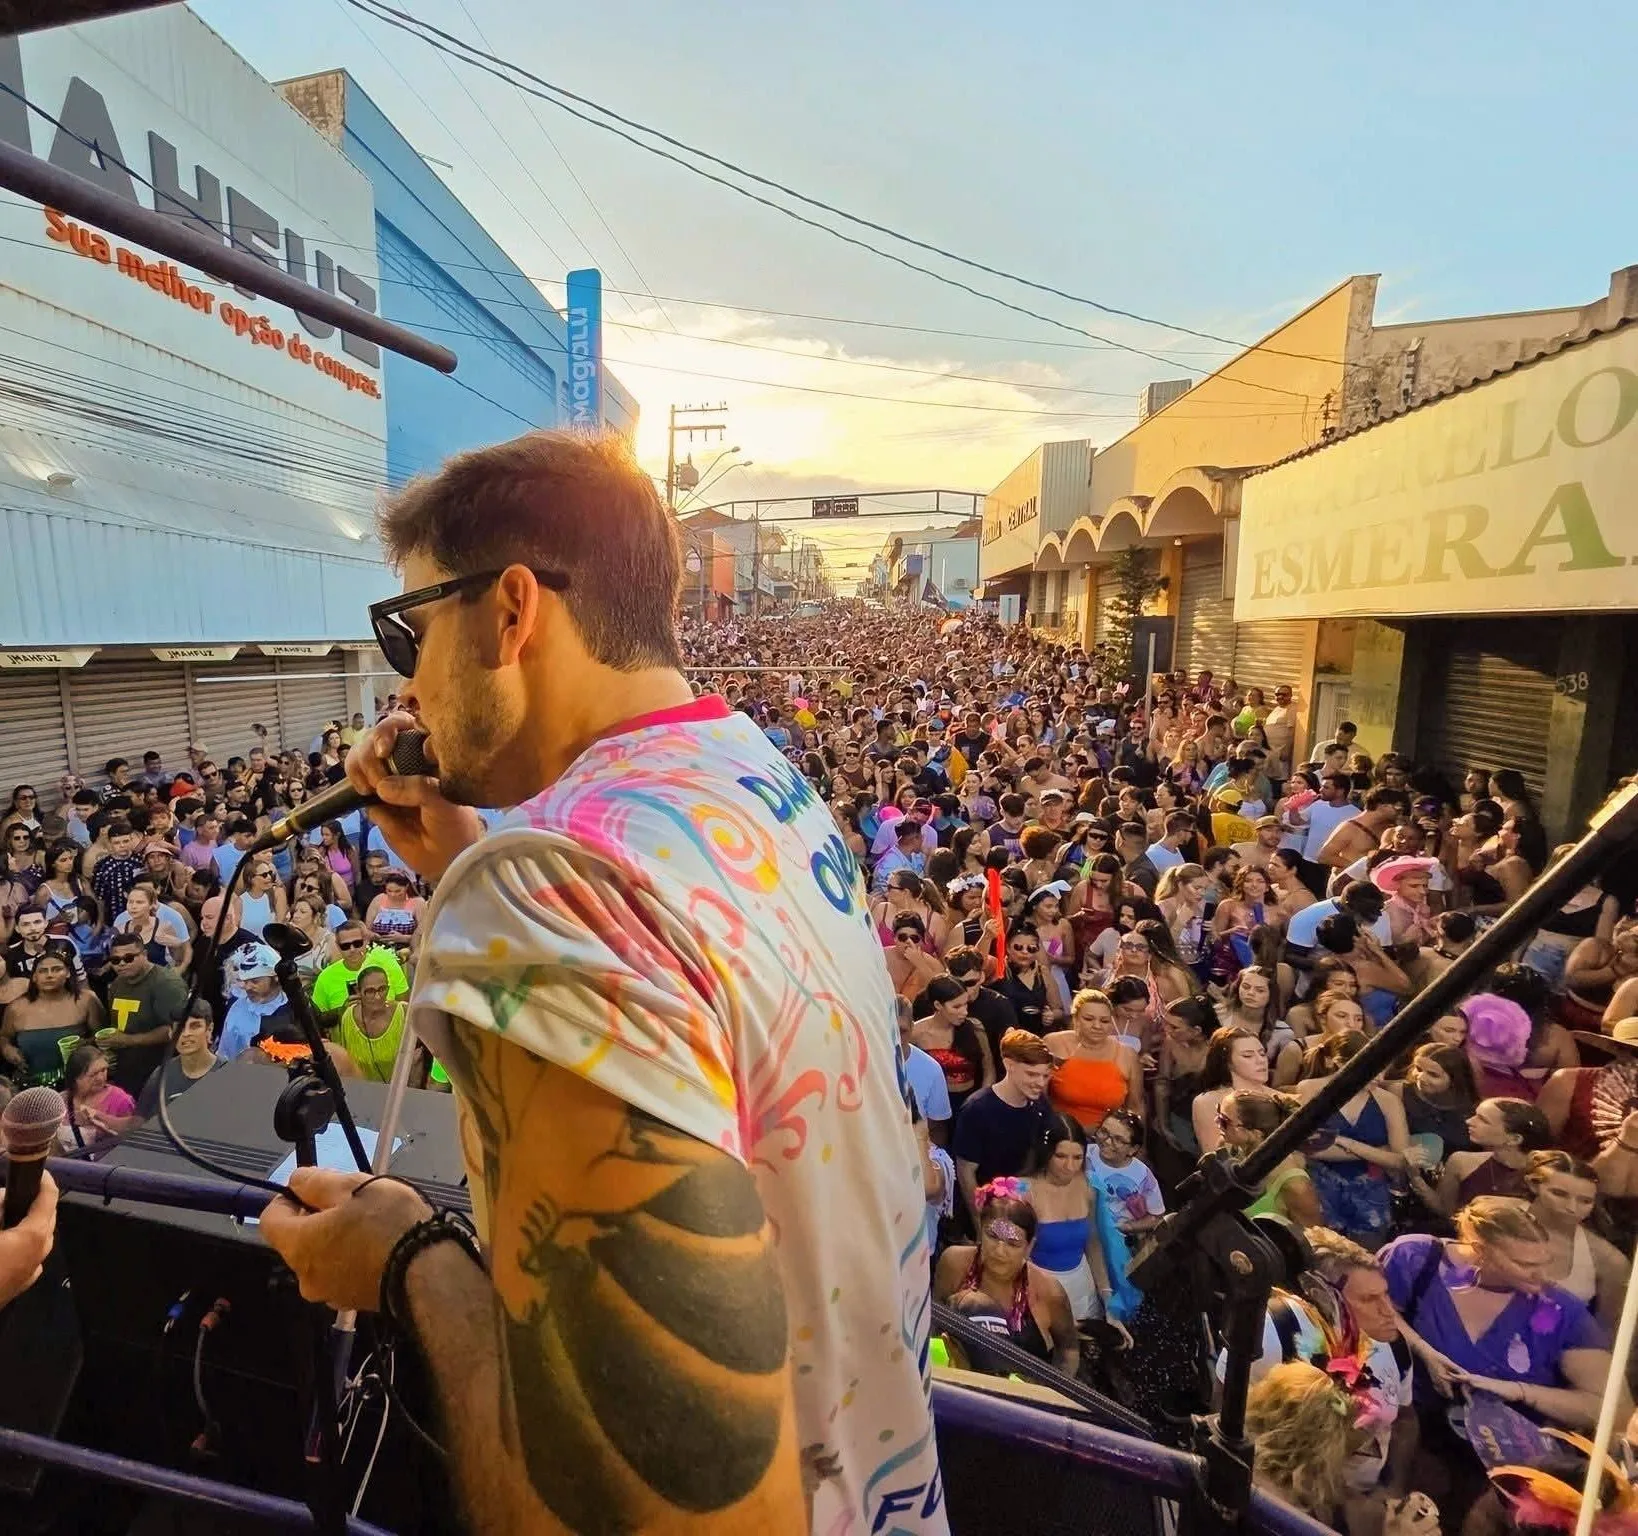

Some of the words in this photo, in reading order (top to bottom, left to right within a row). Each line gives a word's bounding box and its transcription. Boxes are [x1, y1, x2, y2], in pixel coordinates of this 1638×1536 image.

[0, 35, 381, 369] AHFUZ
[43, 205, 112, 265] Sua
[116, 246, 216, 314] melhor
[219, 302, 286, 350] opção
[287, 333, 313, 364] de
[1250, 481, 1638, 601] ESMERA
